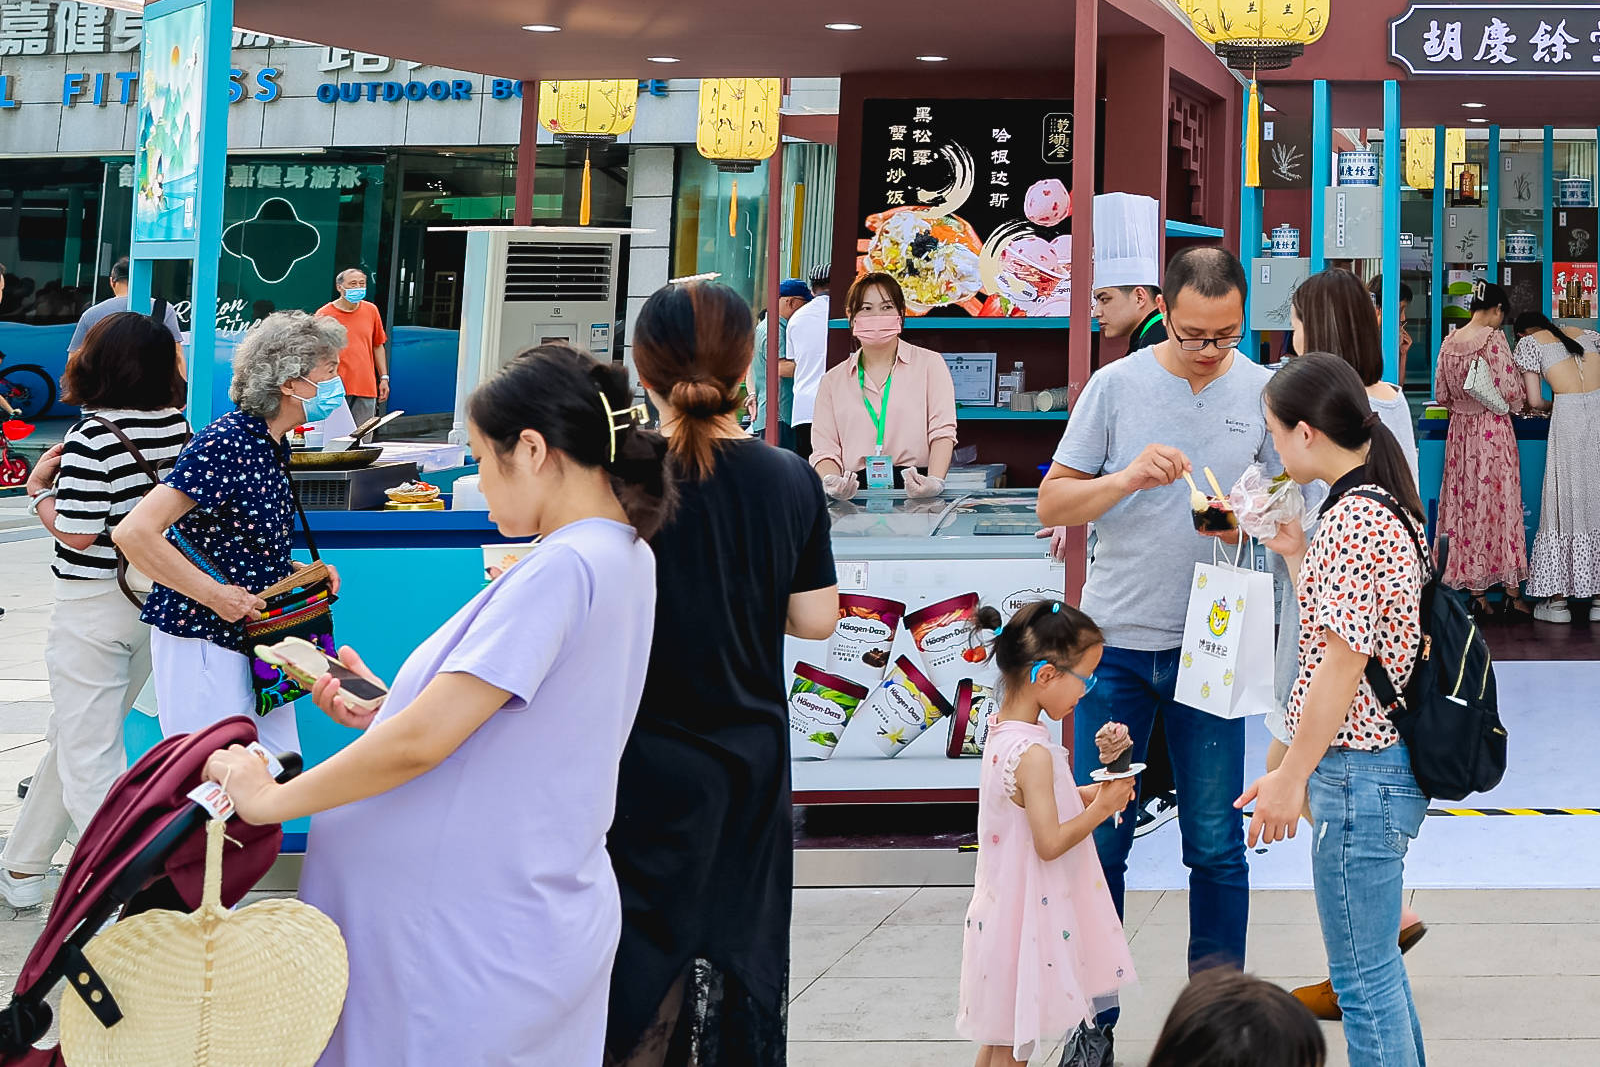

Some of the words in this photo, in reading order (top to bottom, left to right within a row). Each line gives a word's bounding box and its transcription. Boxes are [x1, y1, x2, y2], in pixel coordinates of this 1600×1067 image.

[317, 79, 473, 104] OUTDOOR
[886, 125, 908, 205] 蟹肉炒饭
[912, 106, 932, 165] 黑松露
[989, 128, 1011, 209] 哈根达斯
